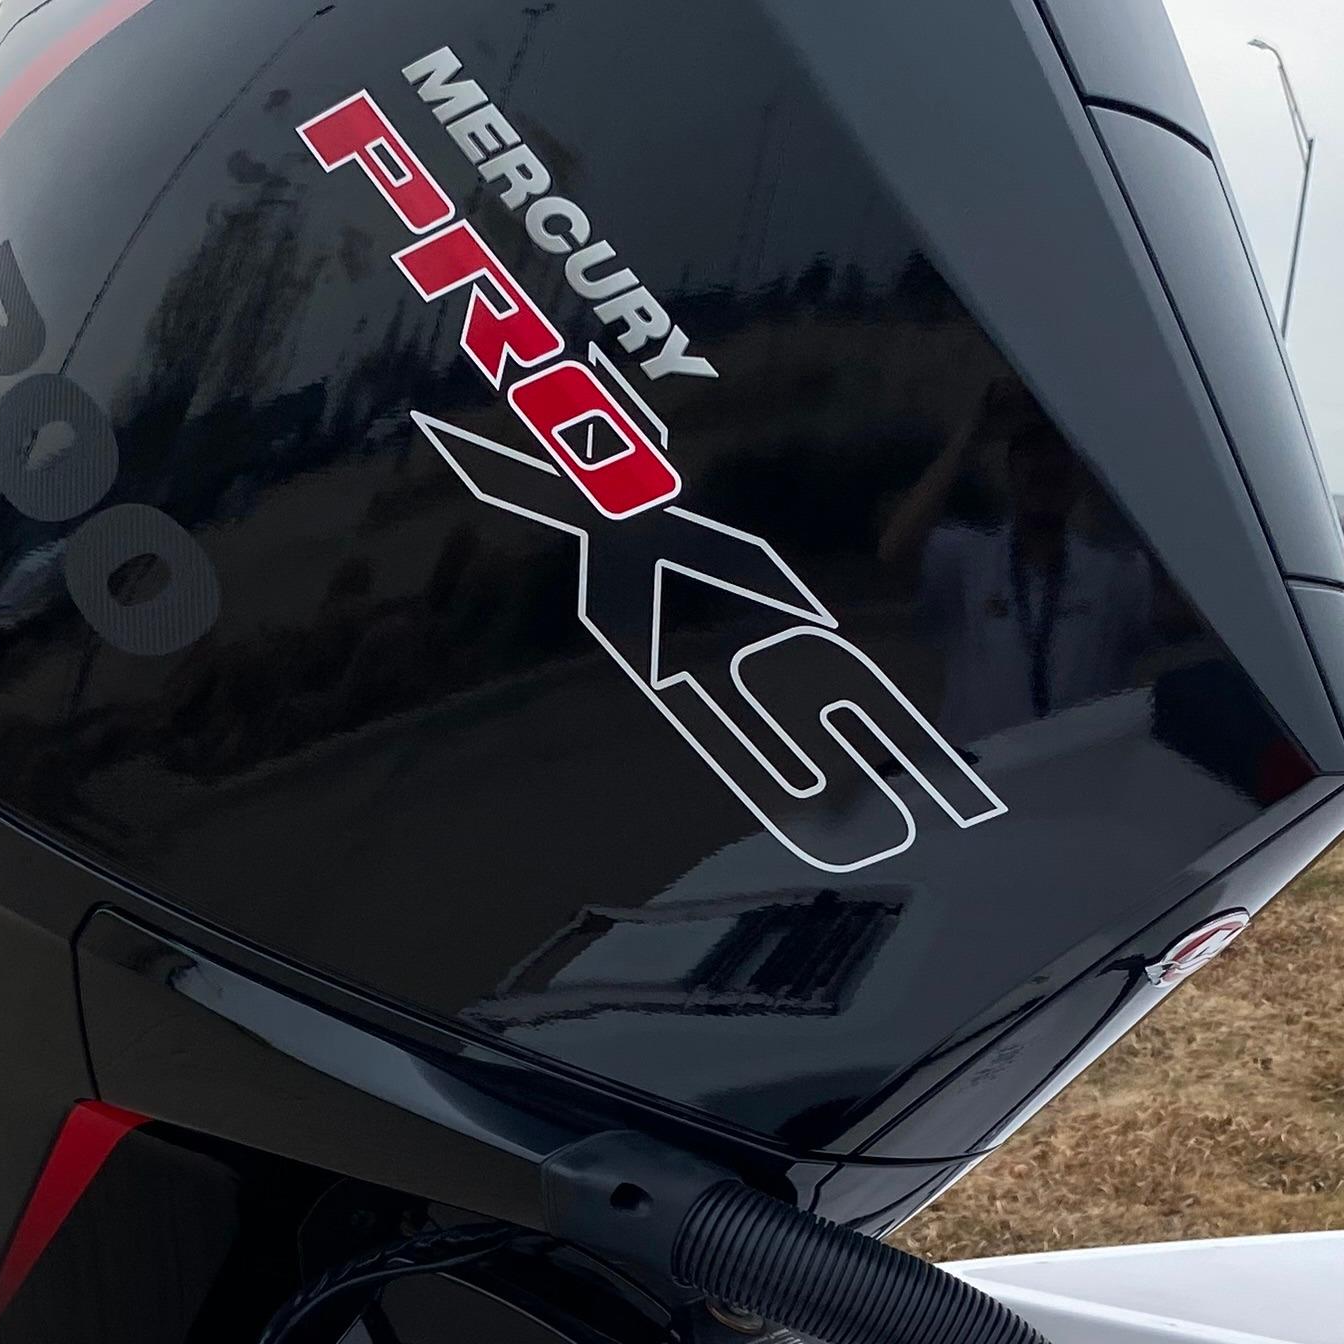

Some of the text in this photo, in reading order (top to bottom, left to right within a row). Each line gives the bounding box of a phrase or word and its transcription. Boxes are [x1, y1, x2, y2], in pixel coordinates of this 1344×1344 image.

[295, 88, 1008, 873] PRO XS
[401, 46, 719, 381] MERCURY
